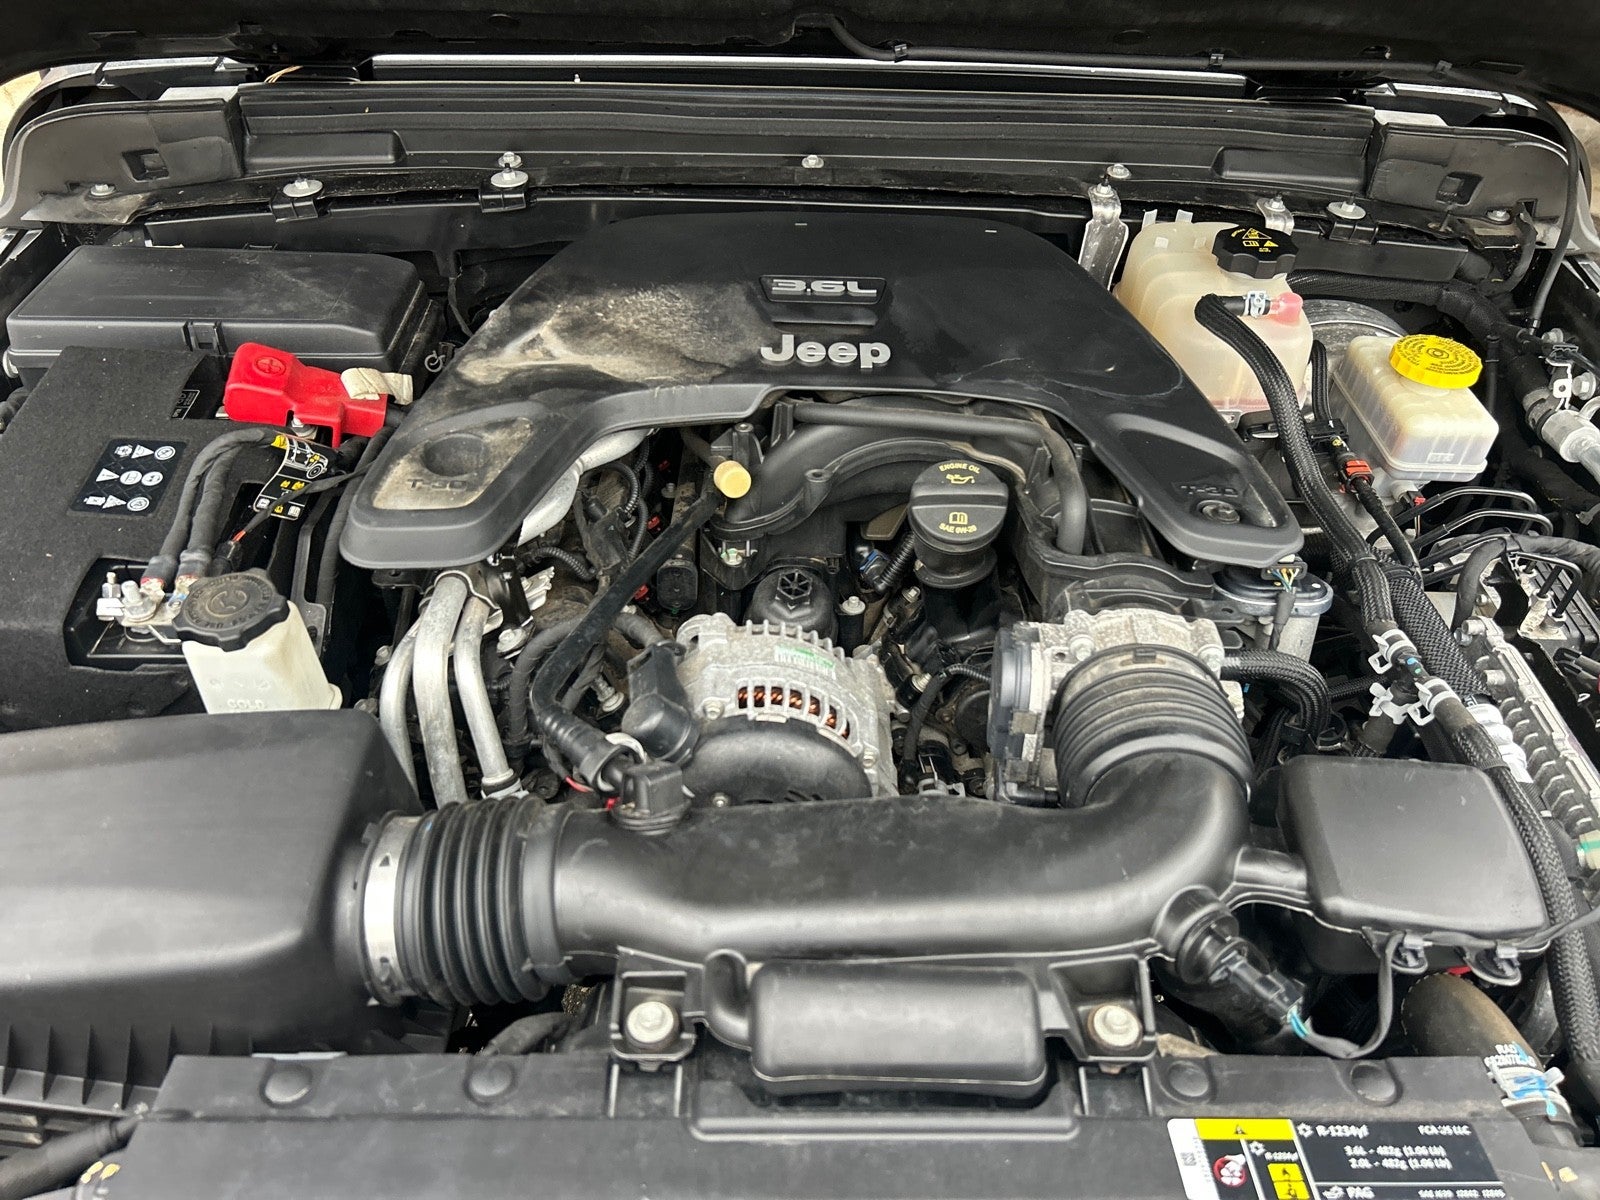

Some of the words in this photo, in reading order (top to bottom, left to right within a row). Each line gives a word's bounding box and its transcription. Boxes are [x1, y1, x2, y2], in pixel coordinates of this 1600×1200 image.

[771, 279, 877, 296] 3.6L
[760, 334, 891, 369] Jeep
[939, 462, 968, 472] ENGINE
[968, 465, 981, 474] OIL
[939, 522, 956, 533] SAE
